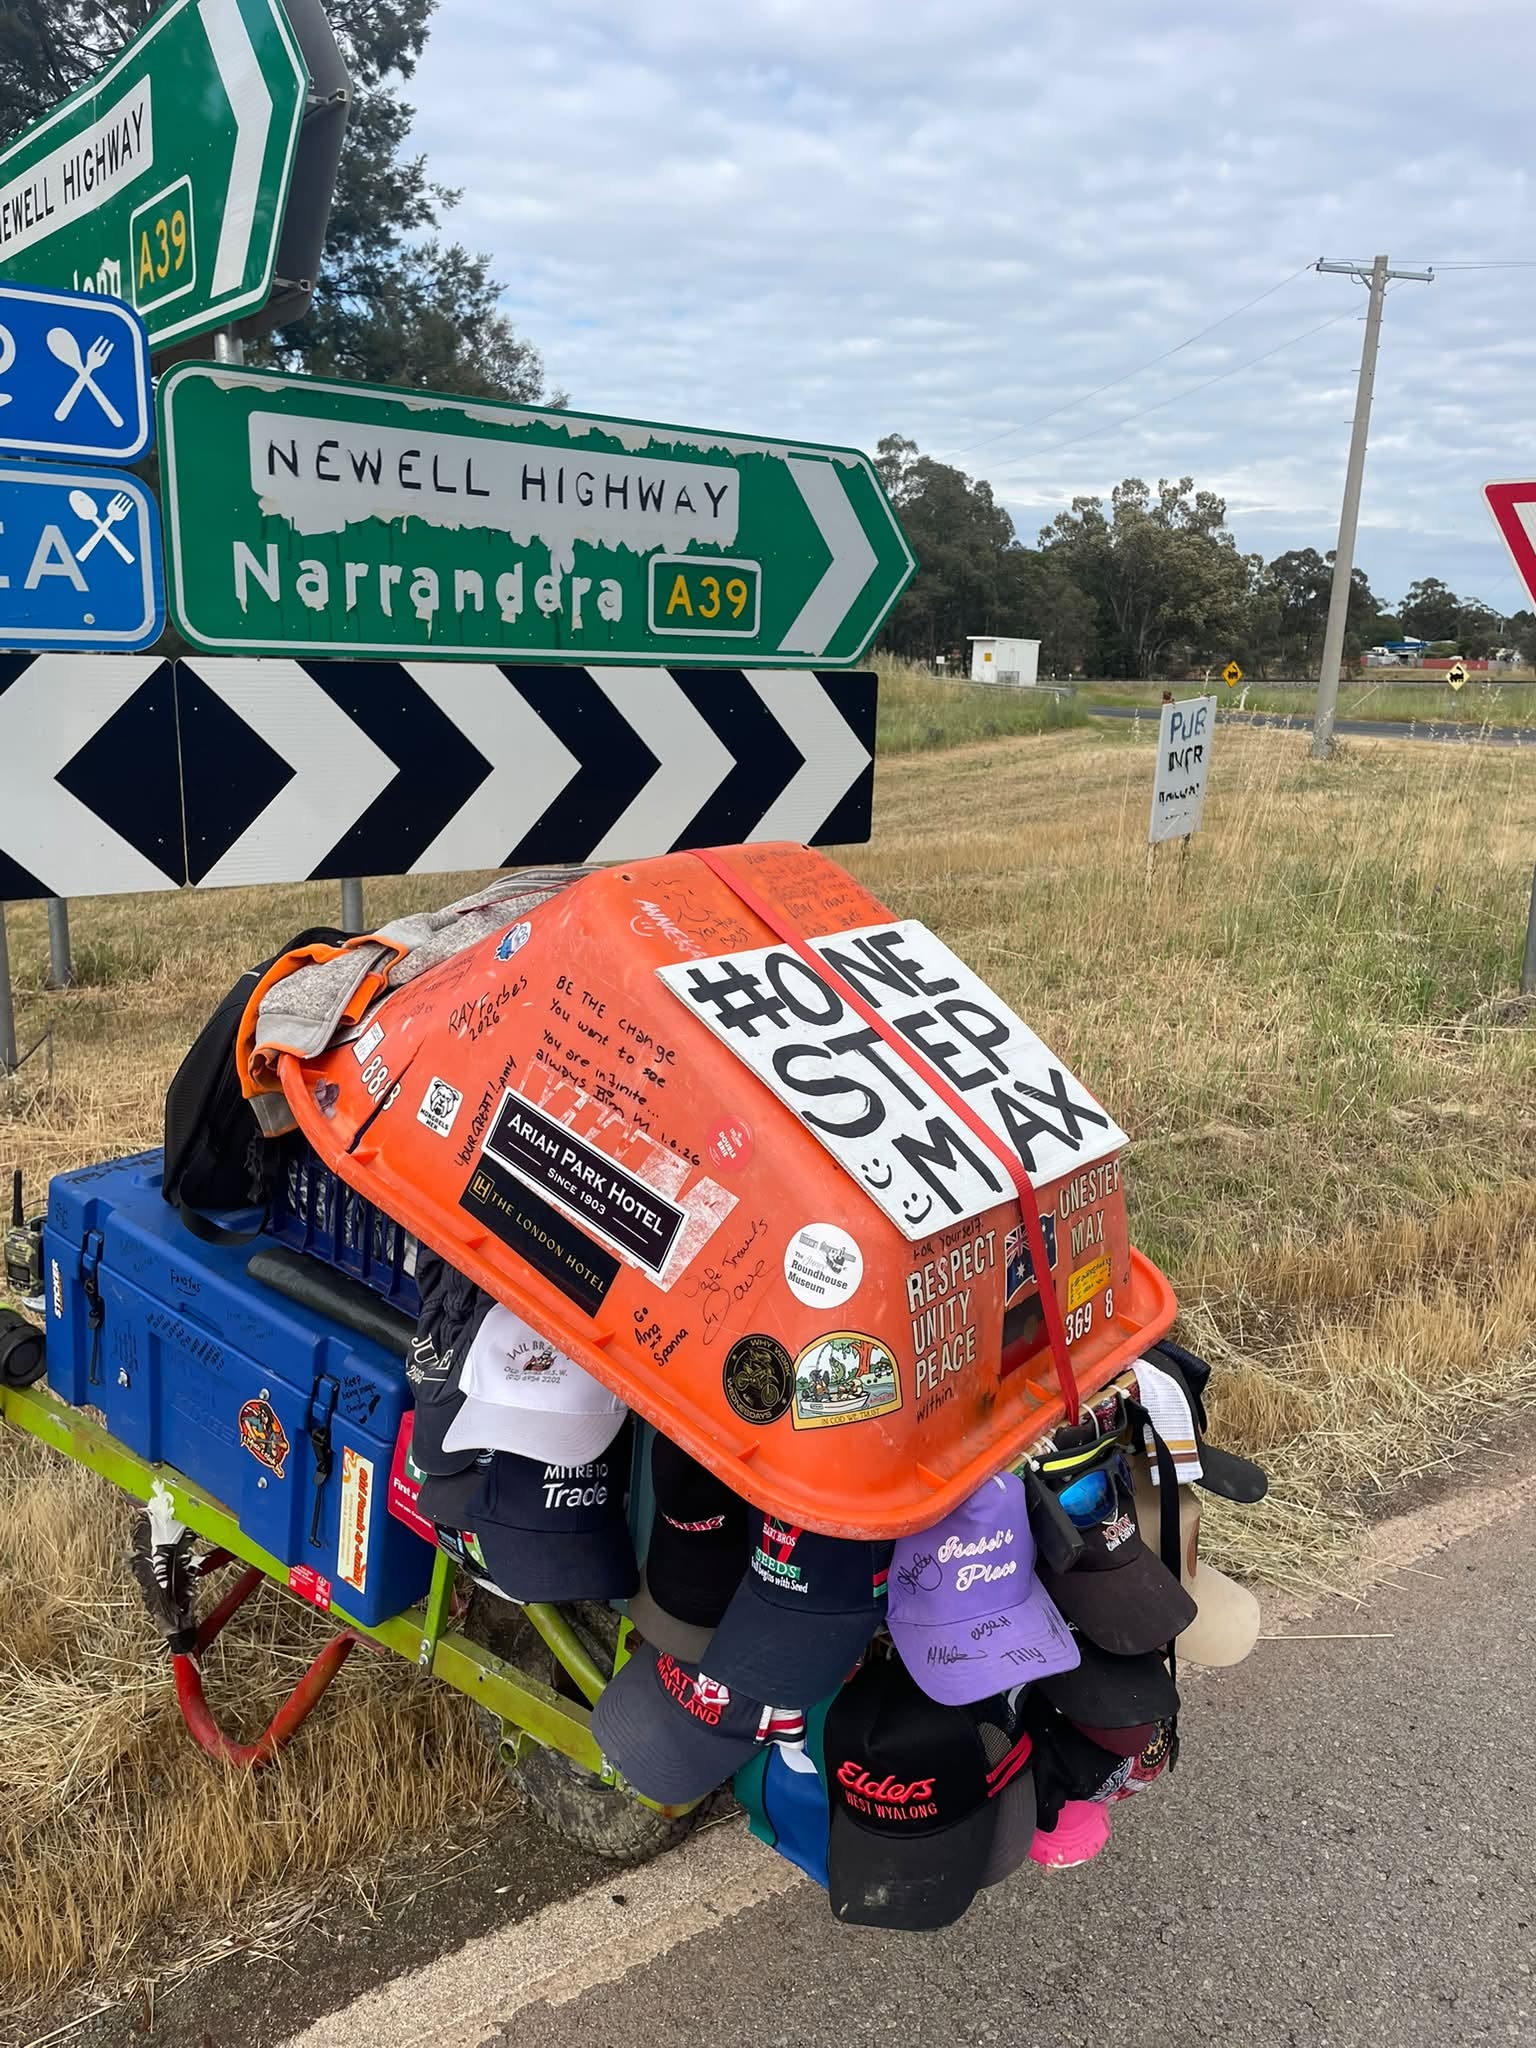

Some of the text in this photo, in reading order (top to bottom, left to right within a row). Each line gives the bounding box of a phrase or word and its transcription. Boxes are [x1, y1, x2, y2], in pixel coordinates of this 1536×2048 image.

[63, 102, 145, 205] HIGHWAY
[138, 209, 187, 290] A39
[267, 438, 730, 521] NEWELL HIGHWAY
[232, 541, 749, 632] Narrandera A39
[556, 975, 574, 996] BE
[582, 990, 606, 1019] THE
[685, 930, 960, 1038] #ONE
[449, 999, 478, 1035] RAY
[468, 1010, 500, 1042] 2026
[535, 1047, 587, 1089] always
[565, 1049, 590, 1068] are
[617, 1046, 635, 1065] to
[771, 998, 1010, 1139] STEP
[419, 1107, 449, 1131] MONGRELS
[425, 1119, 439, 1131] MEN
[718, 1130, 737, 1159] DOUBLE
[891, 1067, 1109, 1216] MAX
[507, 1112, 664, 1237] ARIAH PARK HOTEL
[546, 1167, 607, 1216] SINCE 1903
[491, 1191, 515, 1218] THE
[515, 1212, 564, 1259] LONDON
[565, 1255, 605, 1294] HOTEL
[1070, 1208, 1106, 1259] MAX
[787, 1270, 826, 1296] Museum
[791, 1259, 849, 1290] Roundhouse
[906, 1229, 997, 1314] RESPECT
[633, 1306, 649, 1323] Go
[911, 1287, 972, 1357] UNITY
[1064, 1287, 1114, 1347] 369 8
[749, 1338, 792, 1378] WHY WORK
[914, 1324, 977, 1400] PEACE
[726, 1377, 773, 1420] WEDNESDAYS
[859, 1408, 881, 1419] TRUST
[543, 1464, 594, 1481] MITRE
[541, 1482, 609, 1509] Trade
[775, 1531, 796, 1547] BROS
[937, 1527, 1015, 1565] Isabel's
[755, 1547, 798, 1579] SEEDS
[775, 1575, 791, 1589] with
[955, 1559, 1017, 1593] Place
[1000, 1646, 1047, 1667] Tilly
[656, 1655, 721, 1727] MAITLAND
[836, 1759, 937, 1805] Elders
[845, 1789, 938, 1821] WEST WYALONG
